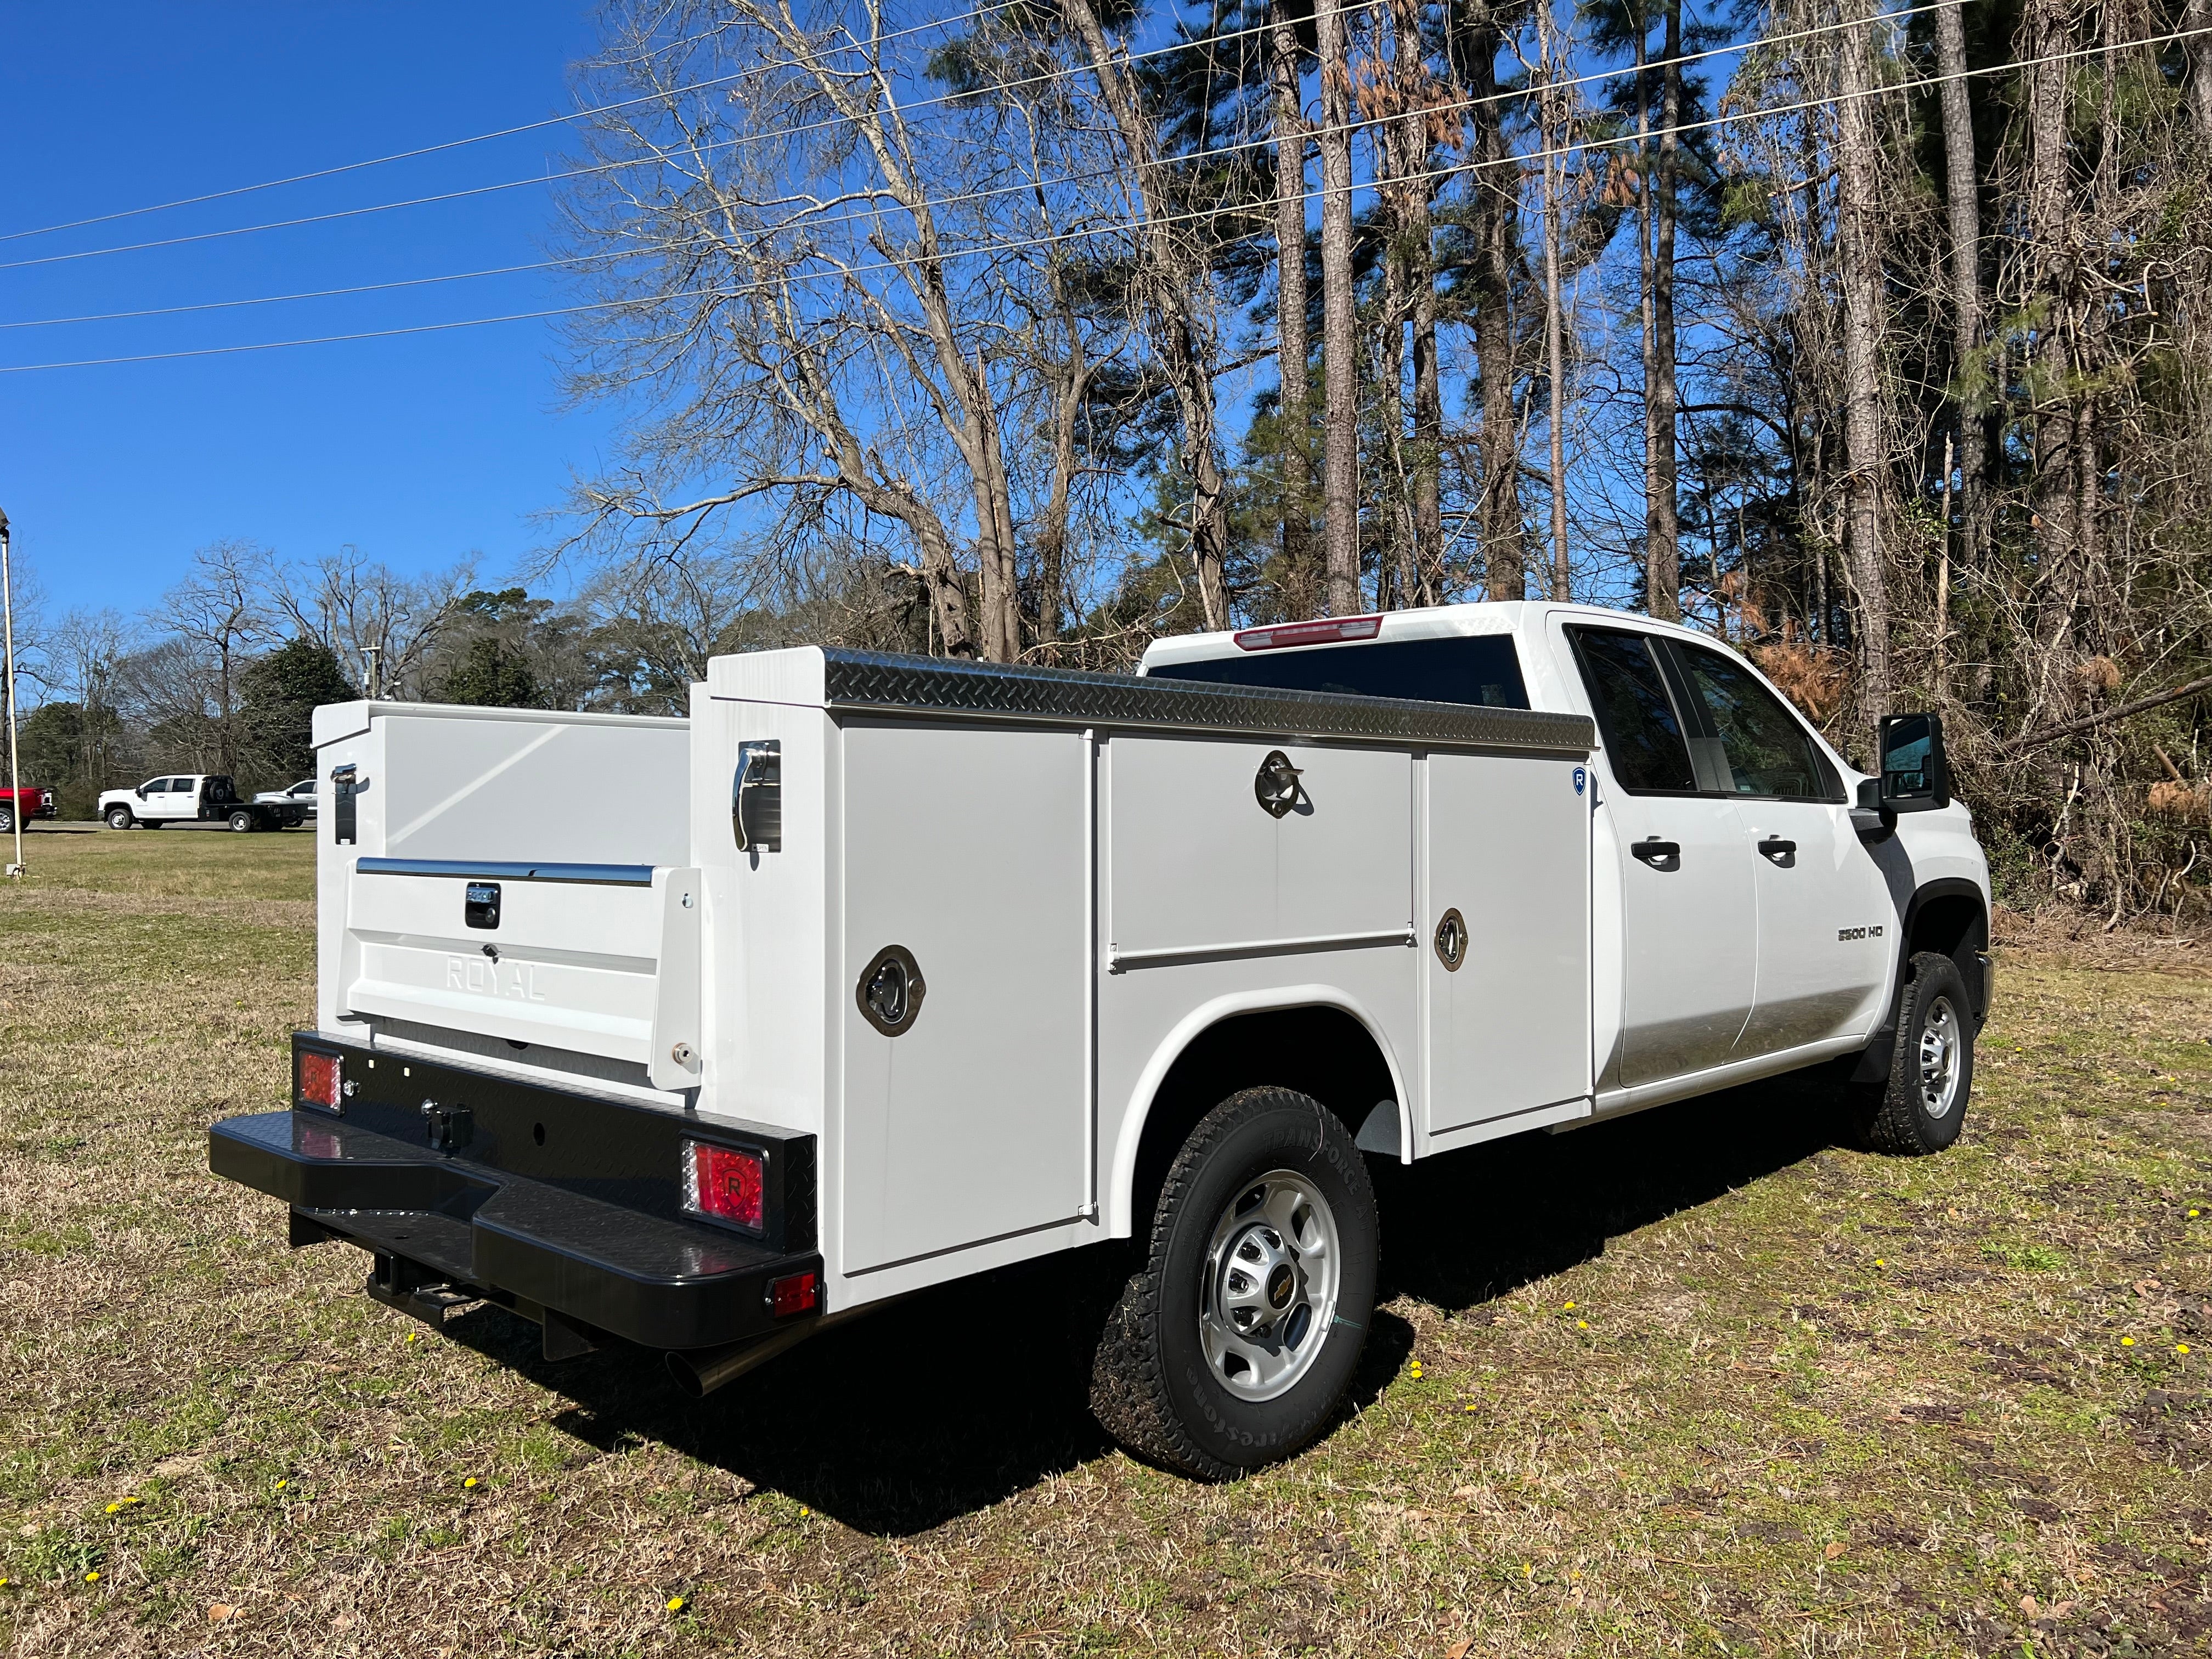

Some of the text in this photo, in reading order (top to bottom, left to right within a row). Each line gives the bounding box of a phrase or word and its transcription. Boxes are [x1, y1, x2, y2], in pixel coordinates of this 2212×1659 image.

[1576, 774, 1583, 786] R
[1838, 926, 1883, 941] 2500 HD
[447, 955, 546, 1001] ROYAL
[1263, 1127, 1362, 1196] TRANSFORCE
[728, 1177, 741, 1197] R
